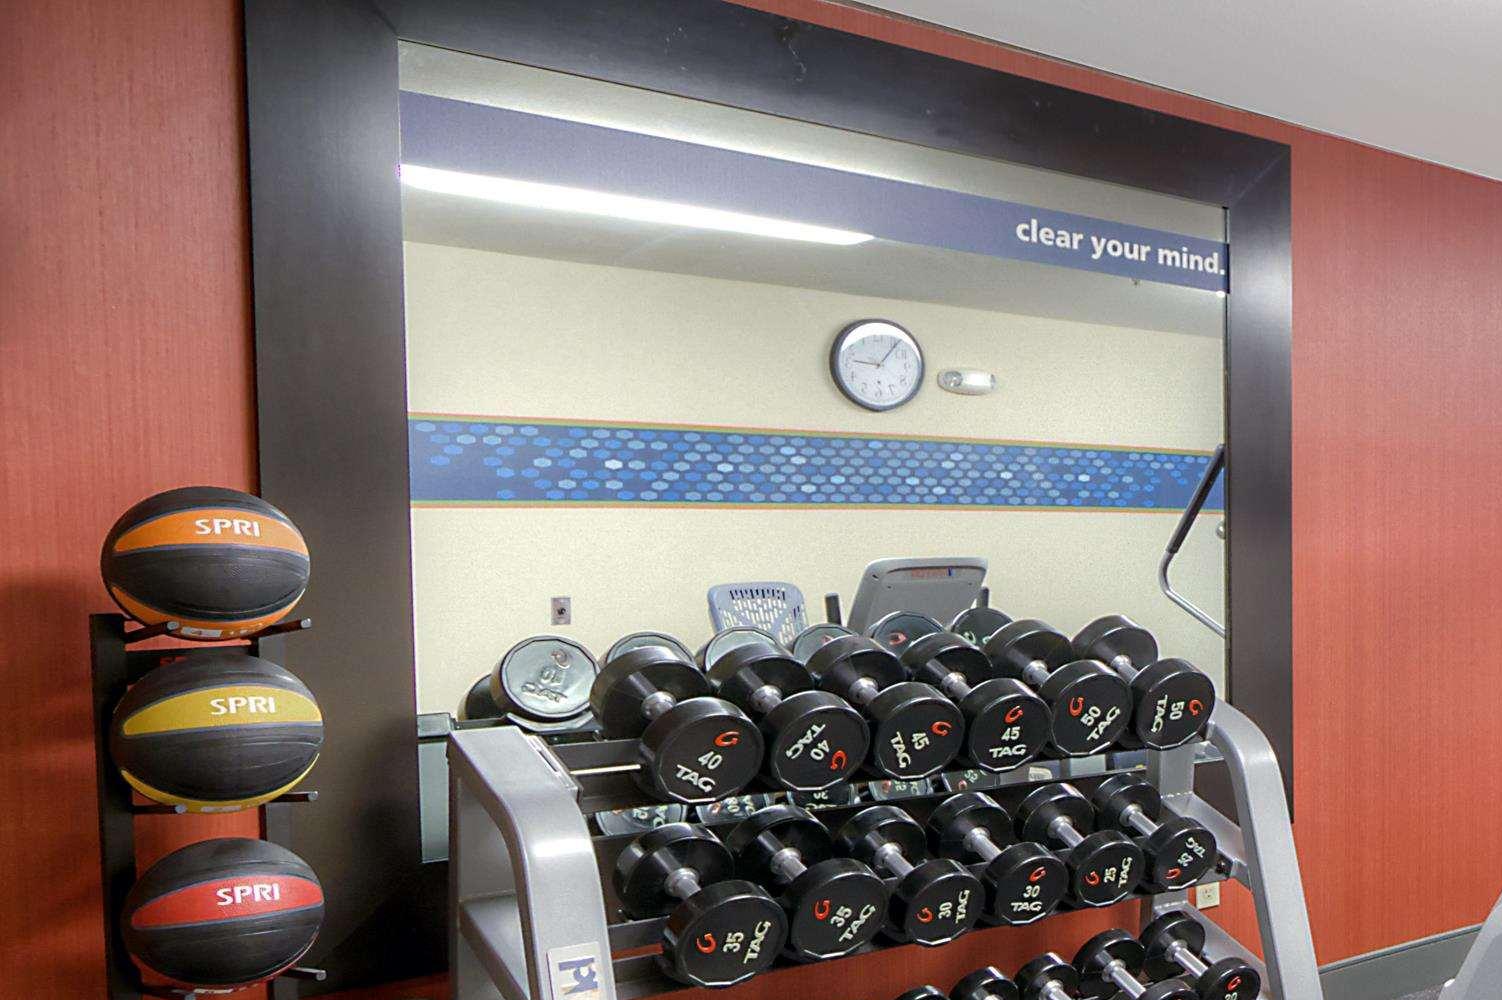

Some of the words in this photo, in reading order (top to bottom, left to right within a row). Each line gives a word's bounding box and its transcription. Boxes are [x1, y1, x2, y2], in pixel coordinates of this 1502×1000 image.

[1015, 218, 1084, 250] clear
[1091, 235, 1152, 263] your
[1157, 246, 1226, 276] mind.
[195, 518, 262, 538] SPRI
[209, 695, 277, 716] SPRI
[1150, 694, 1168, 734] TAG
[1169, 701, 1185, 721] 50
[1080, 706, 1101, 727] 50
[1086, 706, 1121, 742] TAG
[785, 723, 826, 760] TAG
[910, 732, 930, 750] 45
[1001, 726, 1021, 741] 45
[697, 750, 723, 770] 40
[810, 740, 830, 761] 40
[890, 732, 911, 768] TAG
[989, 744, 1027, 758] TAG
[676, 764, 716, 793] TAG
[1185, 837, 1206, 858] TAG
[1104, 866, 1117, 883] 25
[1118, 856, 1133, 889] TAG
[216, 882, 281, 906] SPRI
[1022, 885, 1041, 898] 30
[830, 906, 852, 928] 35
[938, 901, 953, 920] 30
[955, 889, 971, 924] TAG
[1010, 901, 1044, 912] TAG
[839, 904, 877, 943] TAG
[722, 931, 745, 954] 35
[743, 921, 772, 965] TAG
